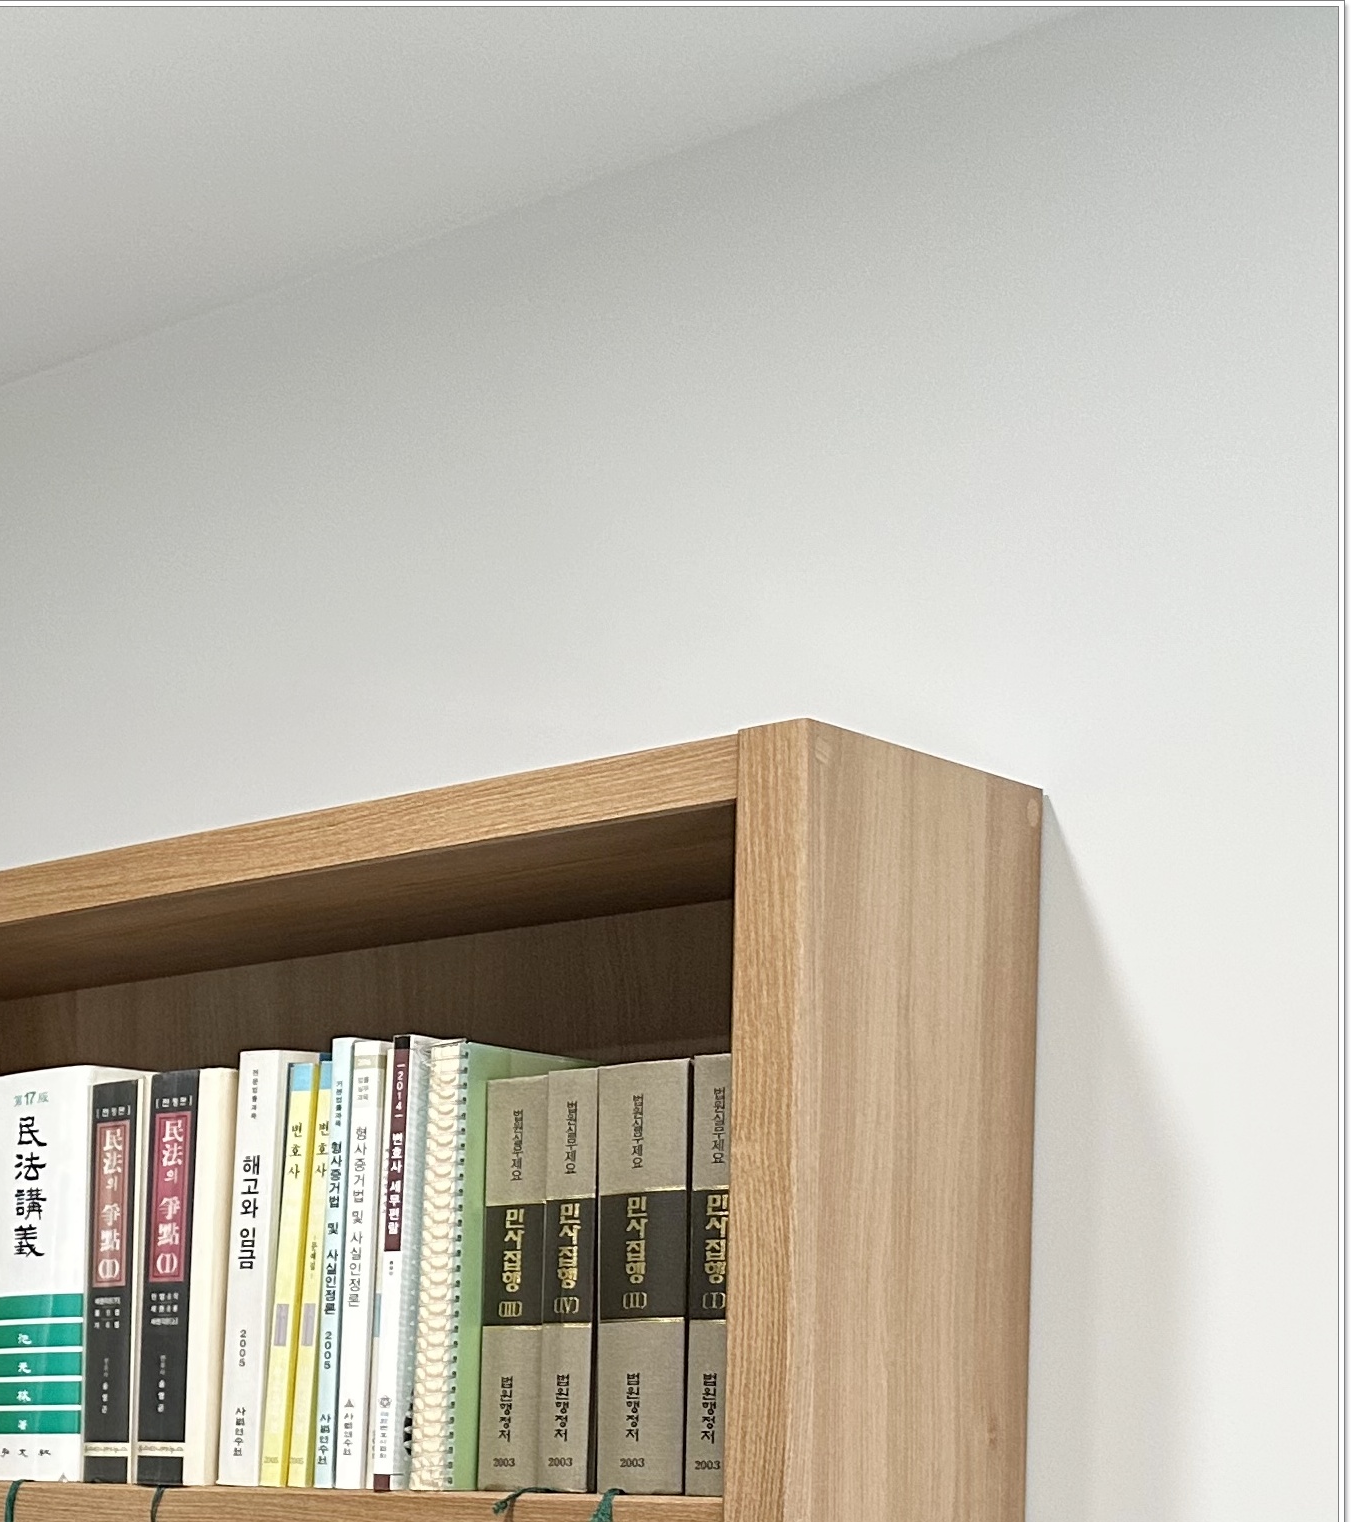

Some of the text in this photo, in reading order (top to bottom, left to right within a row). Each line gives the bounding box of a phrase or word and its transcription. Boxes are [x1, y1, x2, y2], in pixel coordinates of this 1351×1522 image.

[162, 1119, 183, 1184] 民法의
[288, 1121, 303, 1179] 변호사
[314, 1120, 329, 1178] 변호사
[390, 1132, 403, 1174] 변호사
[14, 1116, 47, 1257] 民法講義
[238, 1154, 260, 1269] 해고와 임금
[349, 1126, 367, 1307] 형사증거법 및 사실인정론
[324, 1141, 342, 1315] 형사증거법 및 사실인정론
[502, 1208, 525, 1293] 민사집행
[557, 1202, 581, 1289] 민사집행
[625, 1196, 648, 1284] 민사집행
[704, 1194, 728, 1284] 민사집행
[239, 1329, 247, 1367] 2005
[324, 1331, 332, 1369] 2005
[493, 1457, 516, 1468] 2003
[548, 1457, 573, 1468] 2003
[619, 1457, 645, 1469] 2003
[694, 1460, 721, 1471] 2003
